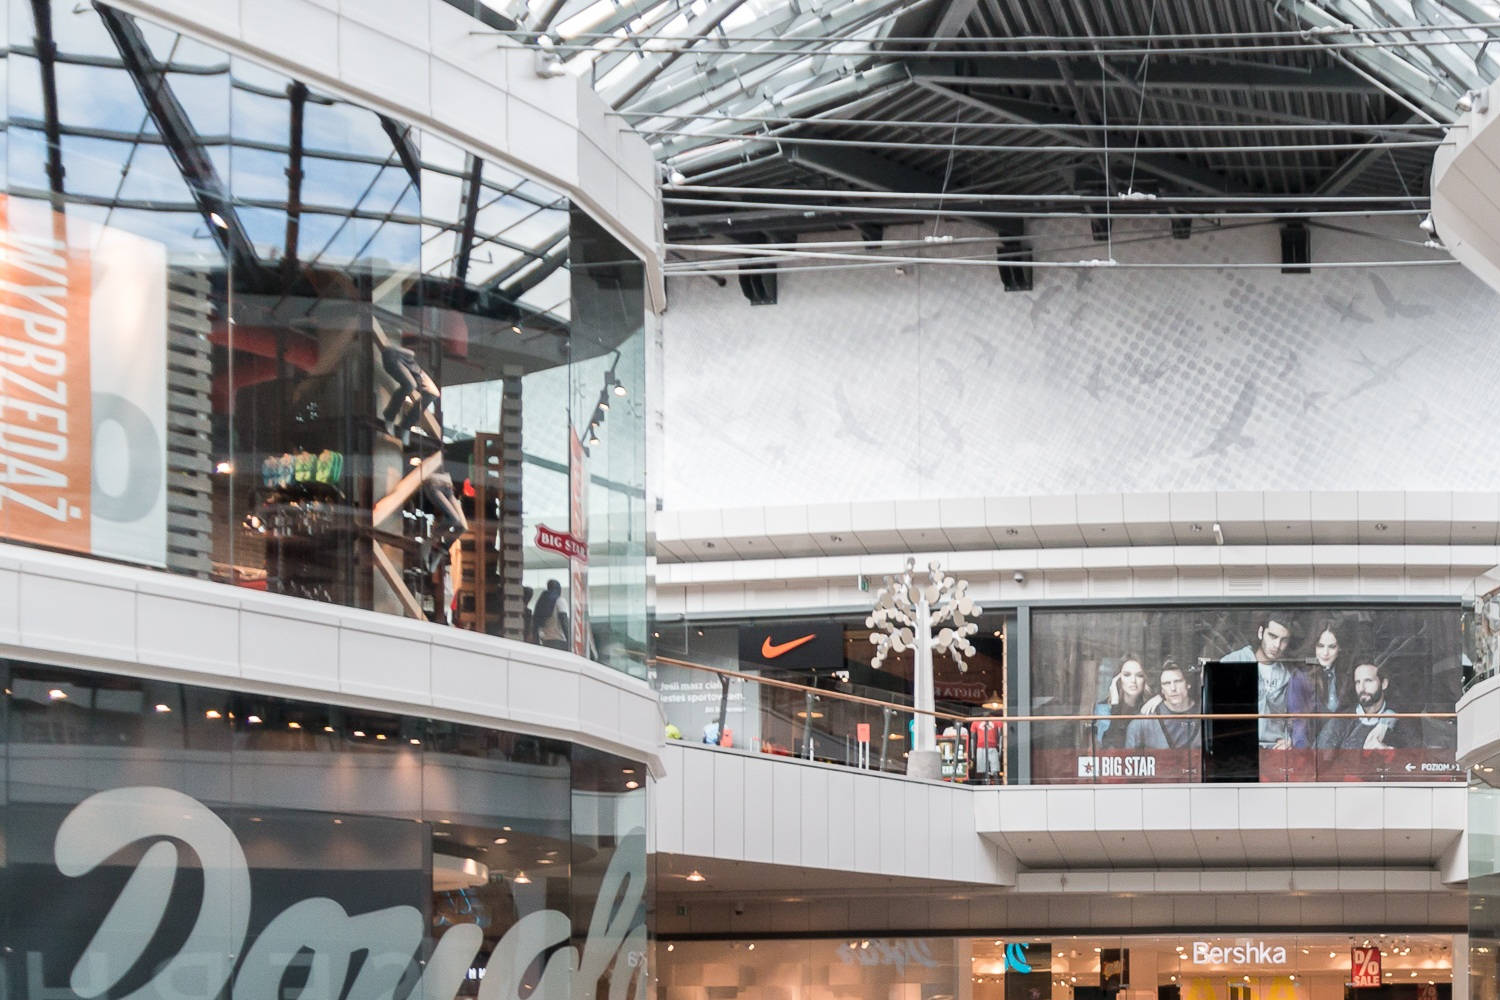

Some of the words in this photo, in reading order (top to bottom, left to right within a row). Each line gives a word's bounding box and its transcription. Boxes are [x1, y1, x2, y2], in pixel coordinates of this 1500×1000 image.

[541, 533, 562, 548] BIG
[1101, 756, 1122, 776] BIG
[1124, 756, 1155, 776] STAR
[1193, 941, 1287, 964] Bershka
[1353, 976, 1380, 986] SALE
